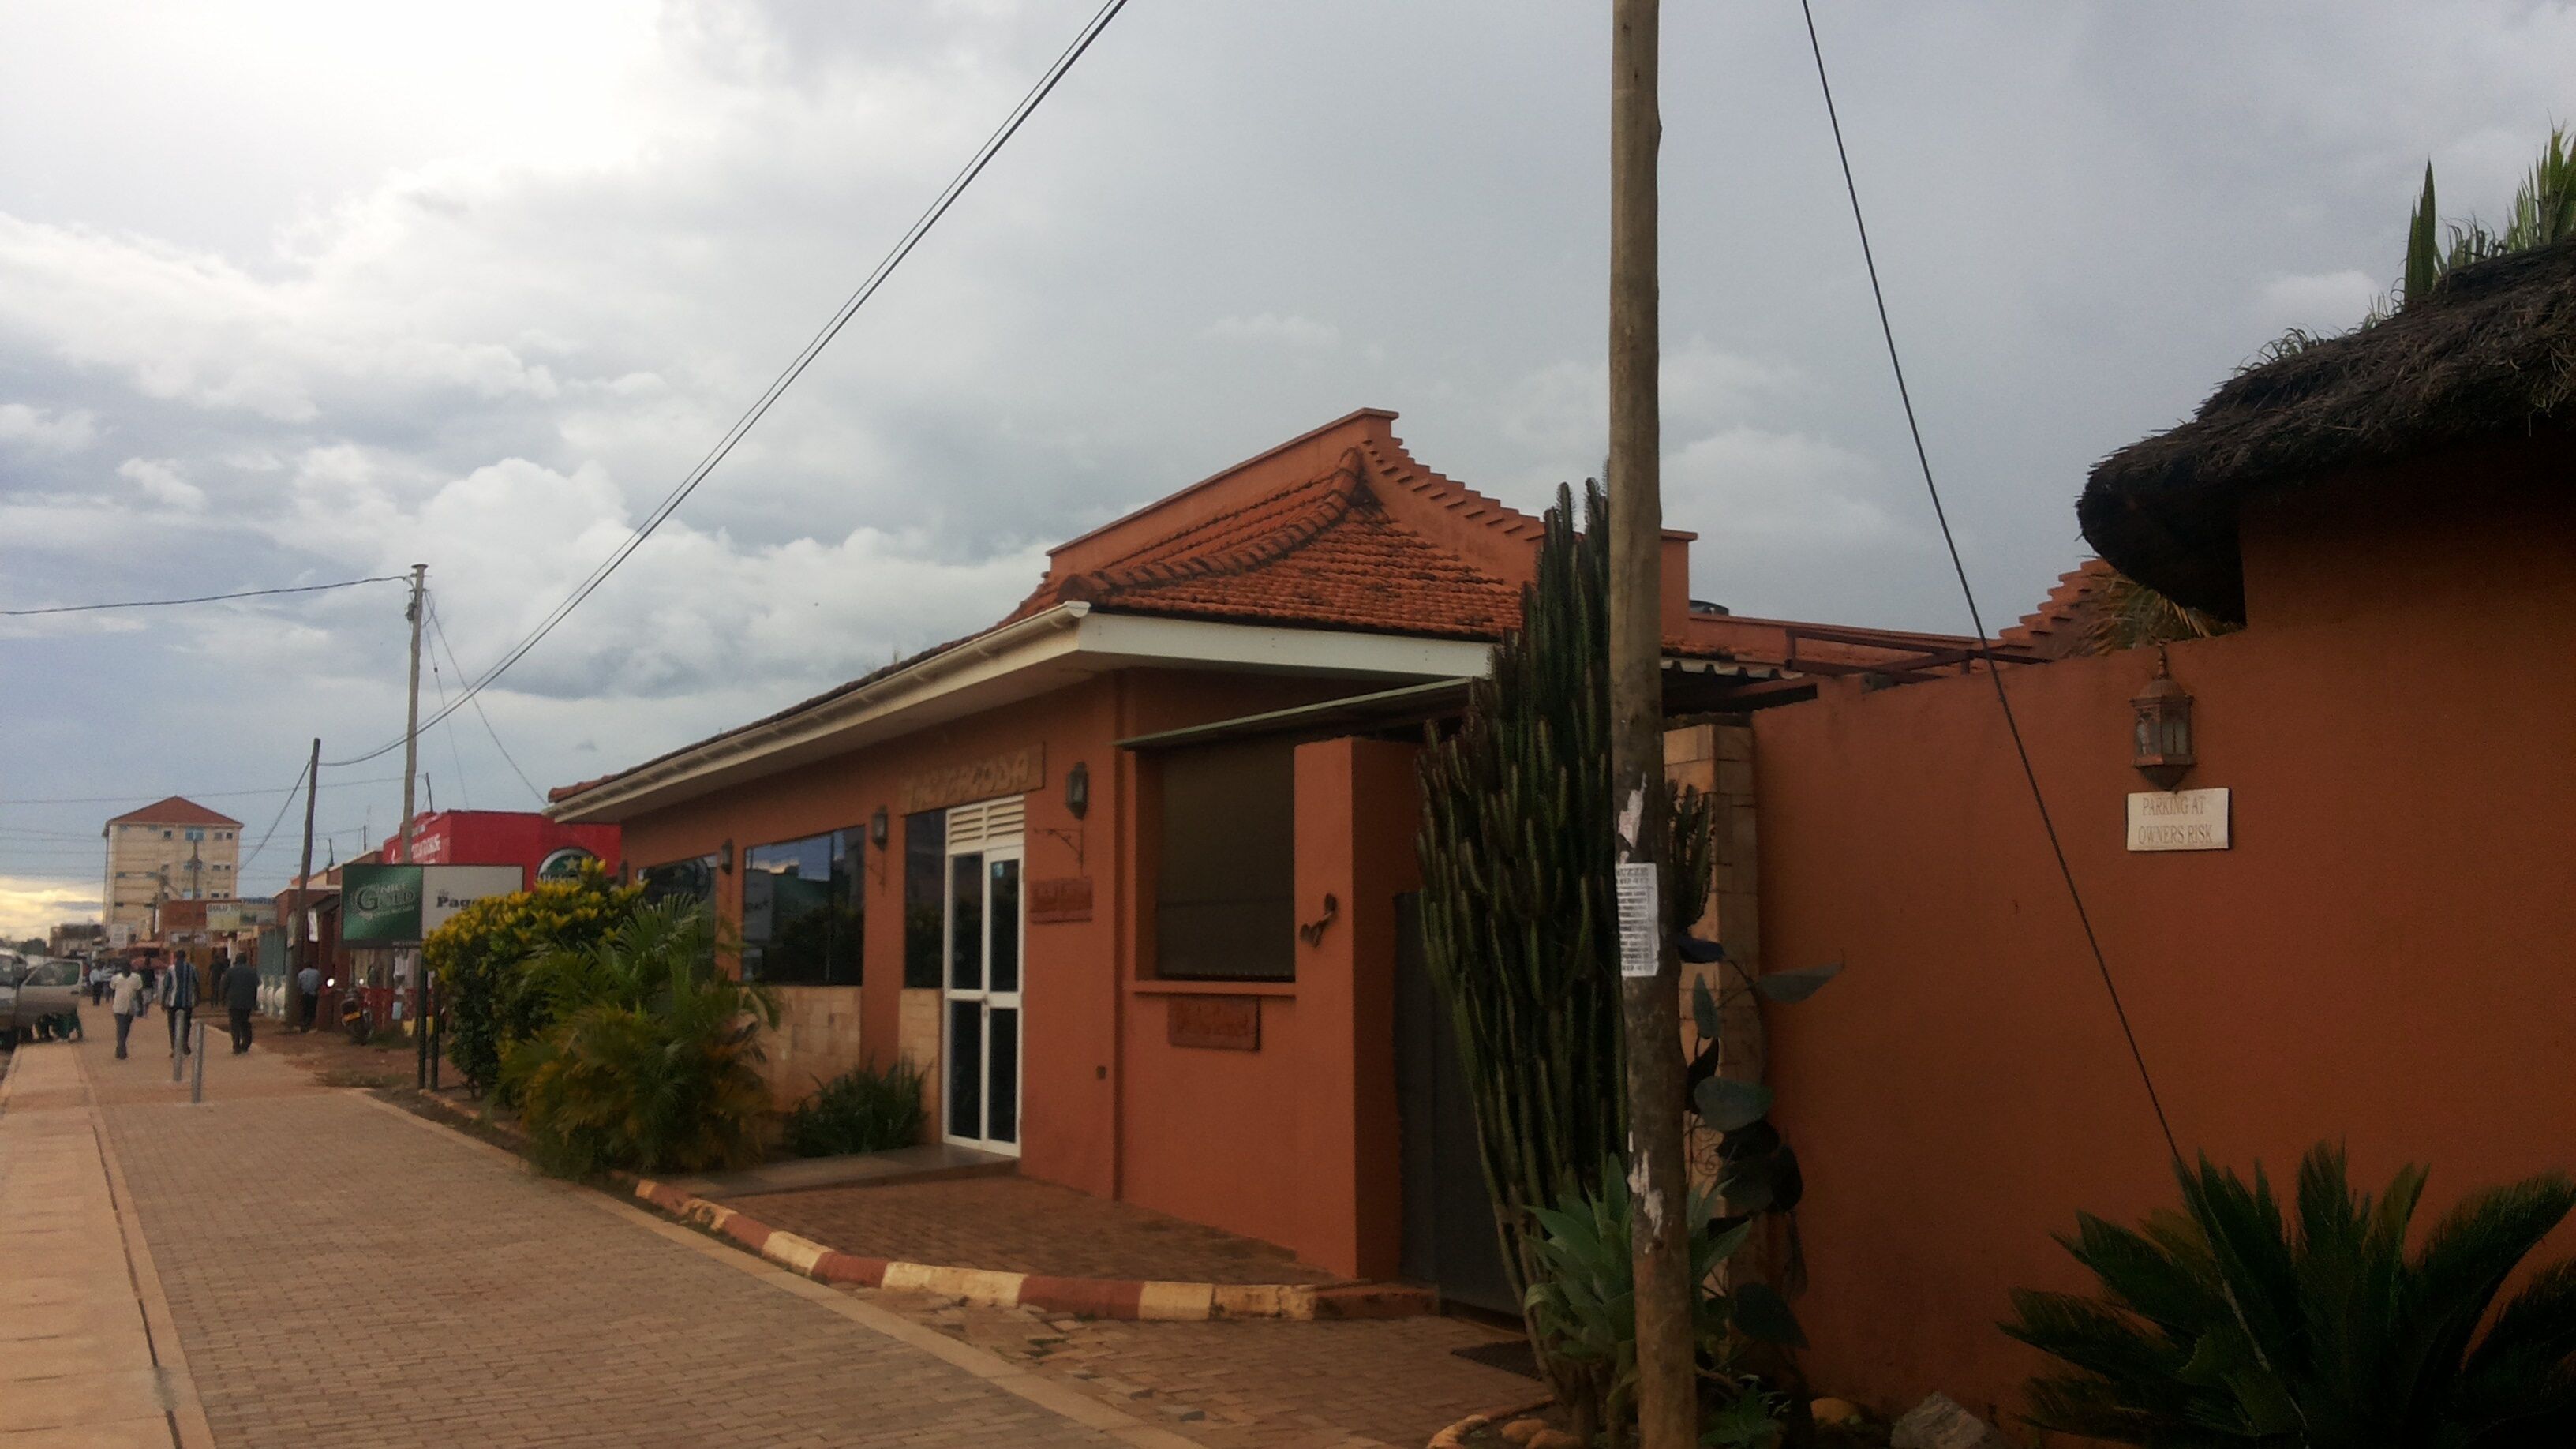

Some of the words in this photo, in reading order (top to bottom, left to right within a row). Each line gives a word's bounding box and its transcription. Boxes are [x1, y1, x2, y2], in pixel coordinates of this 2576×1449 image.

[2142, 796, 2188, 817] PARKING
[2191, 794, 2207, 815] AT
[2138, 825, 2185, 845] OWNERS
[2187, 823, 2213, 844] RISK
[436, 896, 476, 910] Pag
